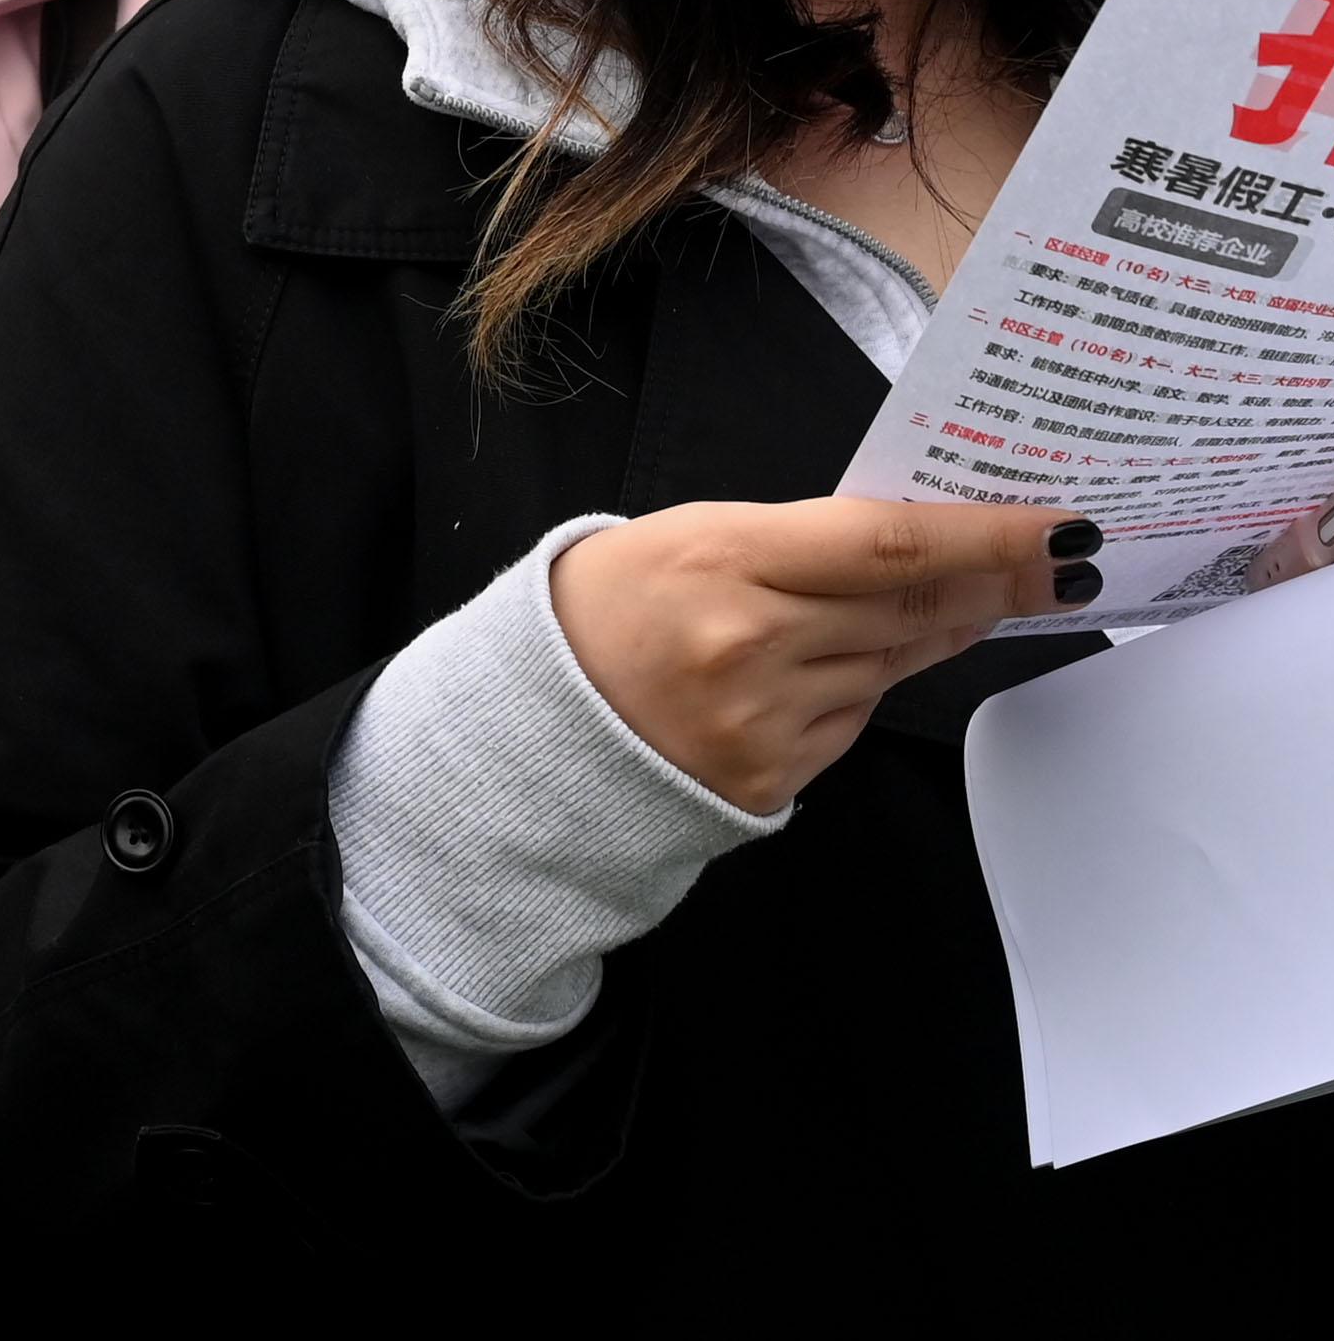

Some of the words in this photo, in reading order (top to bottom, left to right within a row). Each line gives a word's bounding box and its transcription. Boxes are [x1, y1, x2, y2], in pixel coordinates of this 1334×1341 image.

[1113, 208, 1272, 266] 高校推荐企业
